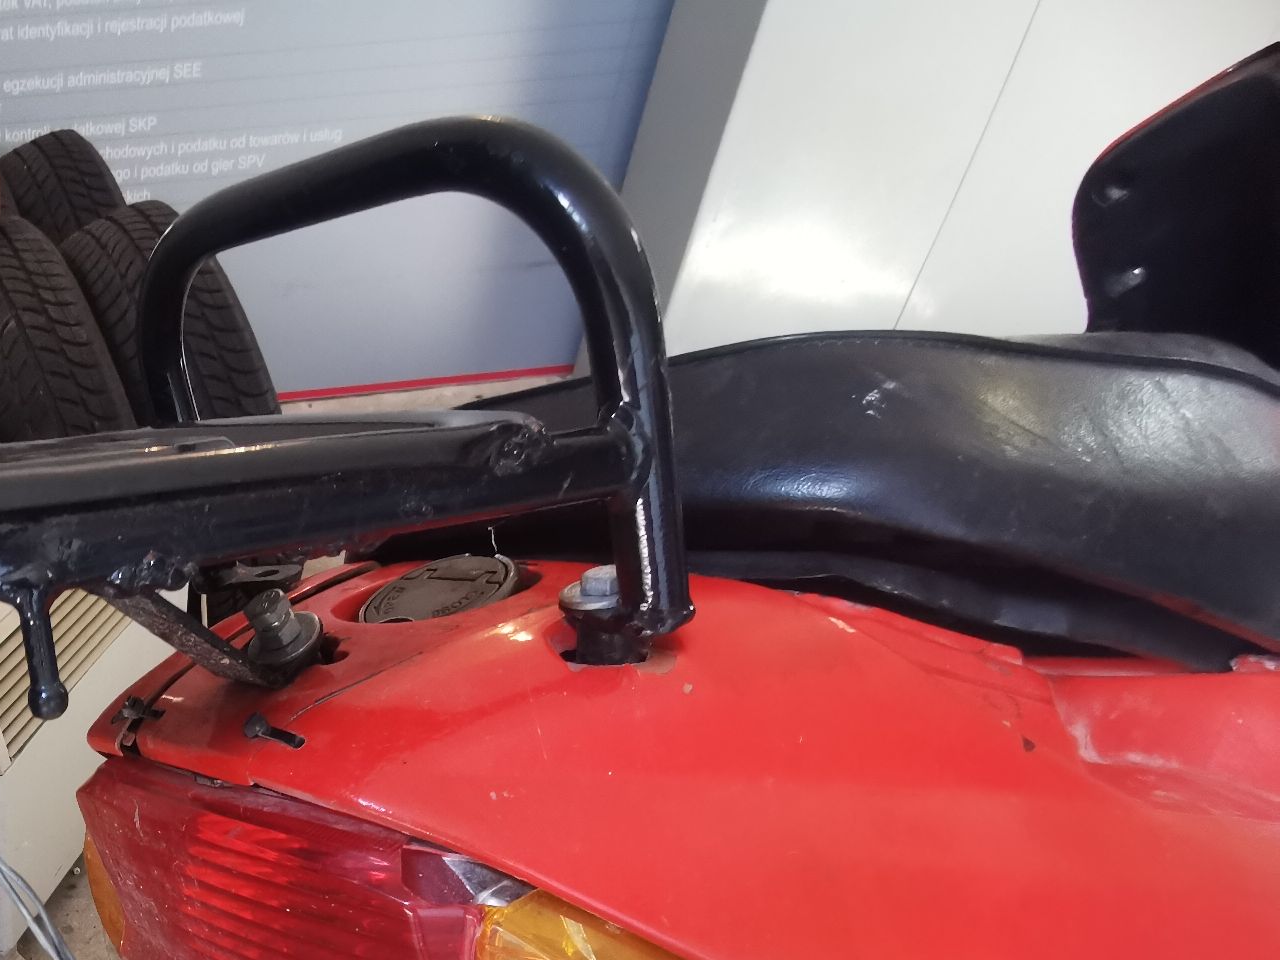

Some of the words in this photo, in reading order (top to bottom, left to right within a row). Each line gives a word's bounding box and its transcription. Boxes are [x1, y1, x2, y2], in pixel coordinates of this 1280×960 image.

[17, 19, 93, 41] identyfikacji
[104, 13, 167, 36] rejestracji
[171, 8, 245, 32] podatkowej
[3, 73, 64, 95] egzekucji
[68, 65, 170, 88] administracyjnej
[174, 62, 202, 79] SEE
[129, 116, 158, 133] SKP
[178, 137, 227, 157] podatku
[229, 134, 247, 149] od
[140, 160, 189, 181] podatku
[192, 159, 209, 173] od
[211, 158, 235, 176] gier
[237, 153, 267, 170] SPV
